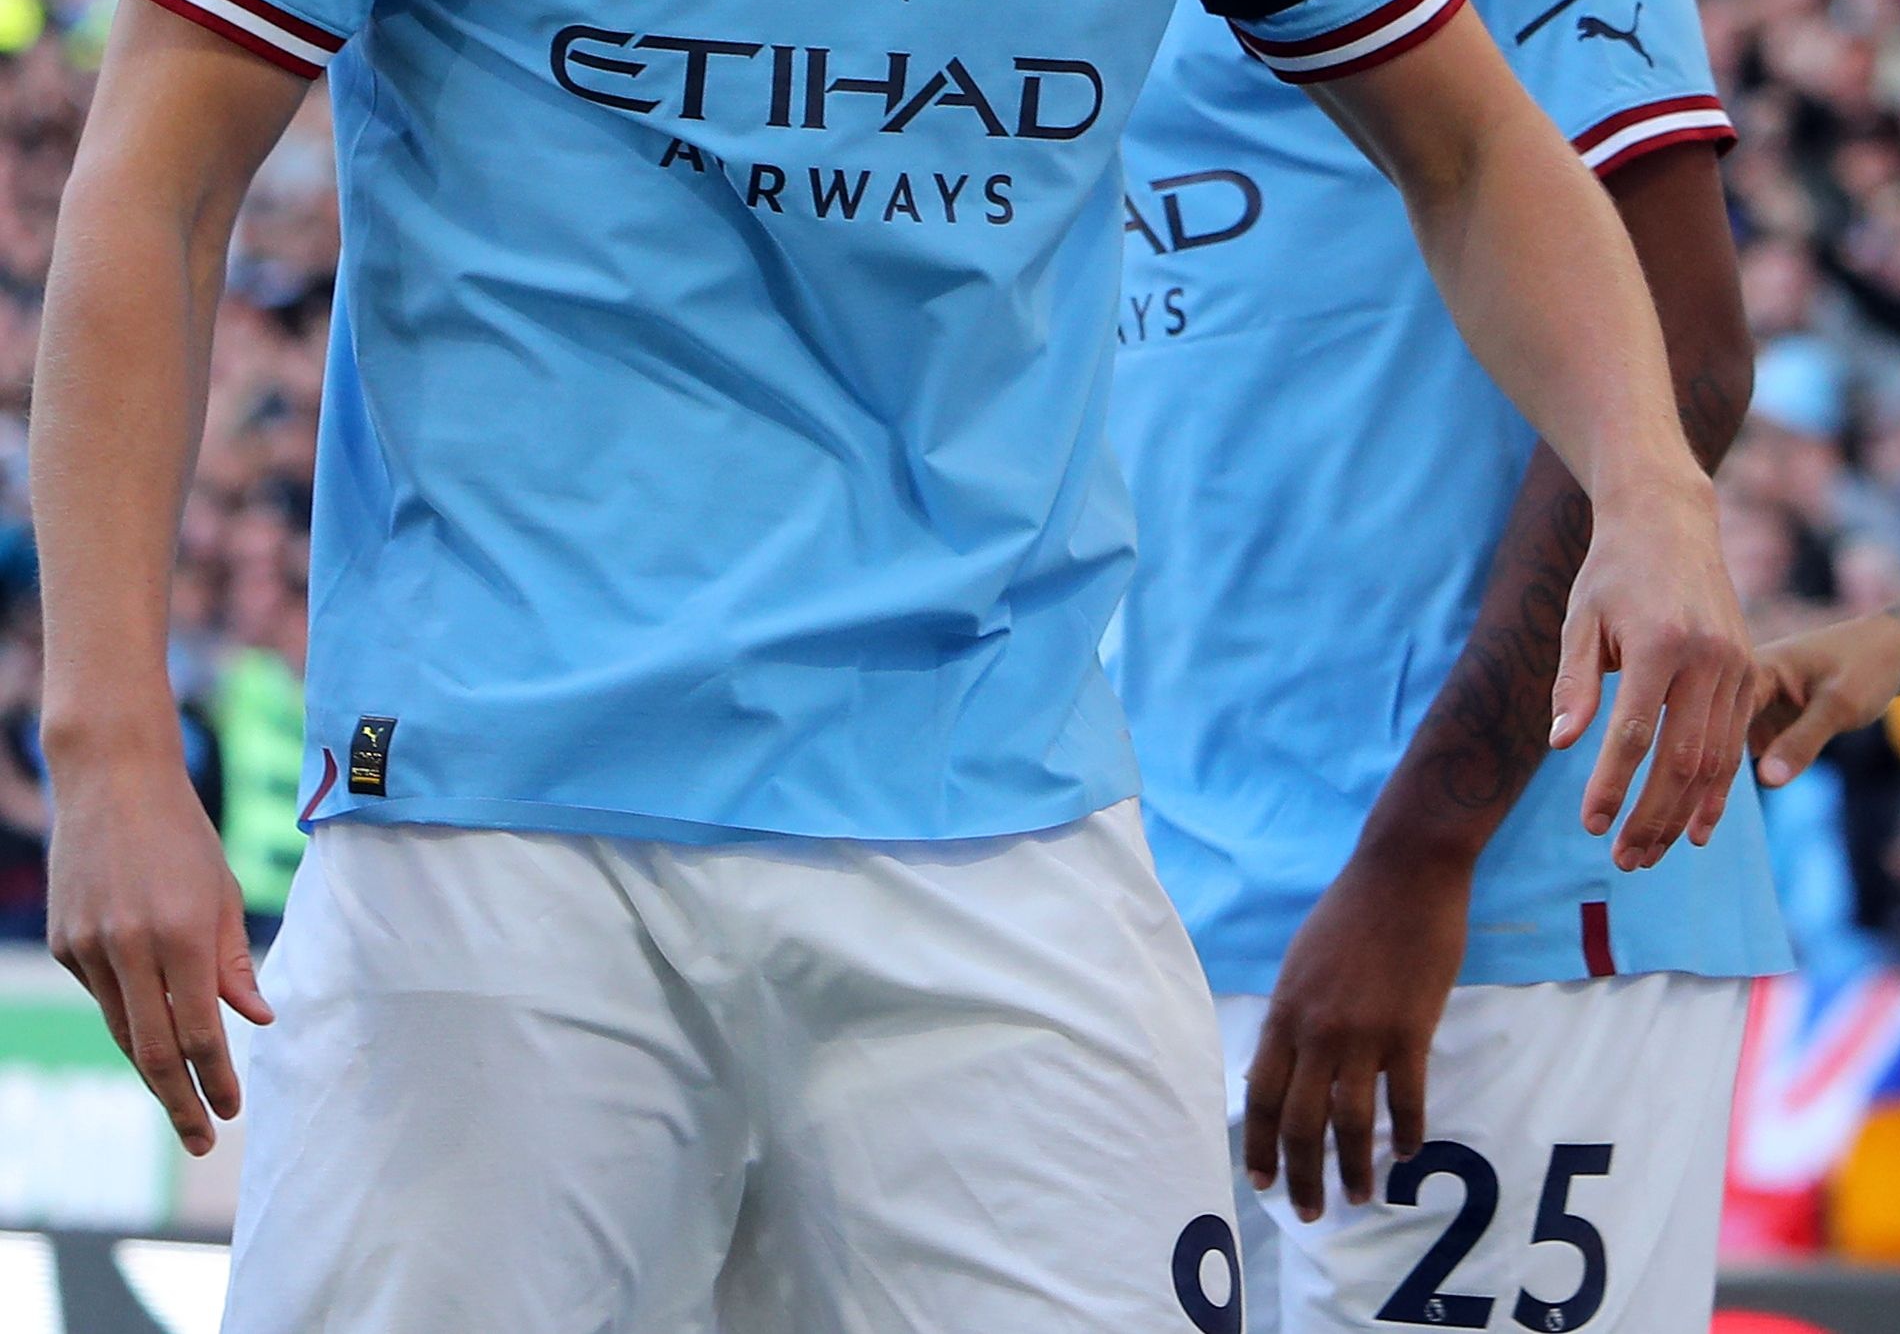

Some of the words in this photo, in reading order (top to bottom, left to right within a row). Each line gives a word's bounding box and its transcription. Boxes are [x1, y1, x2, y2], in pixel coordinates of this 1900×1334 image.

[549, 23, 1103, 141] ETIHAD
[1118, 287, 1187, 344] YS
[1373, 1139, 1615, 1334] 25
